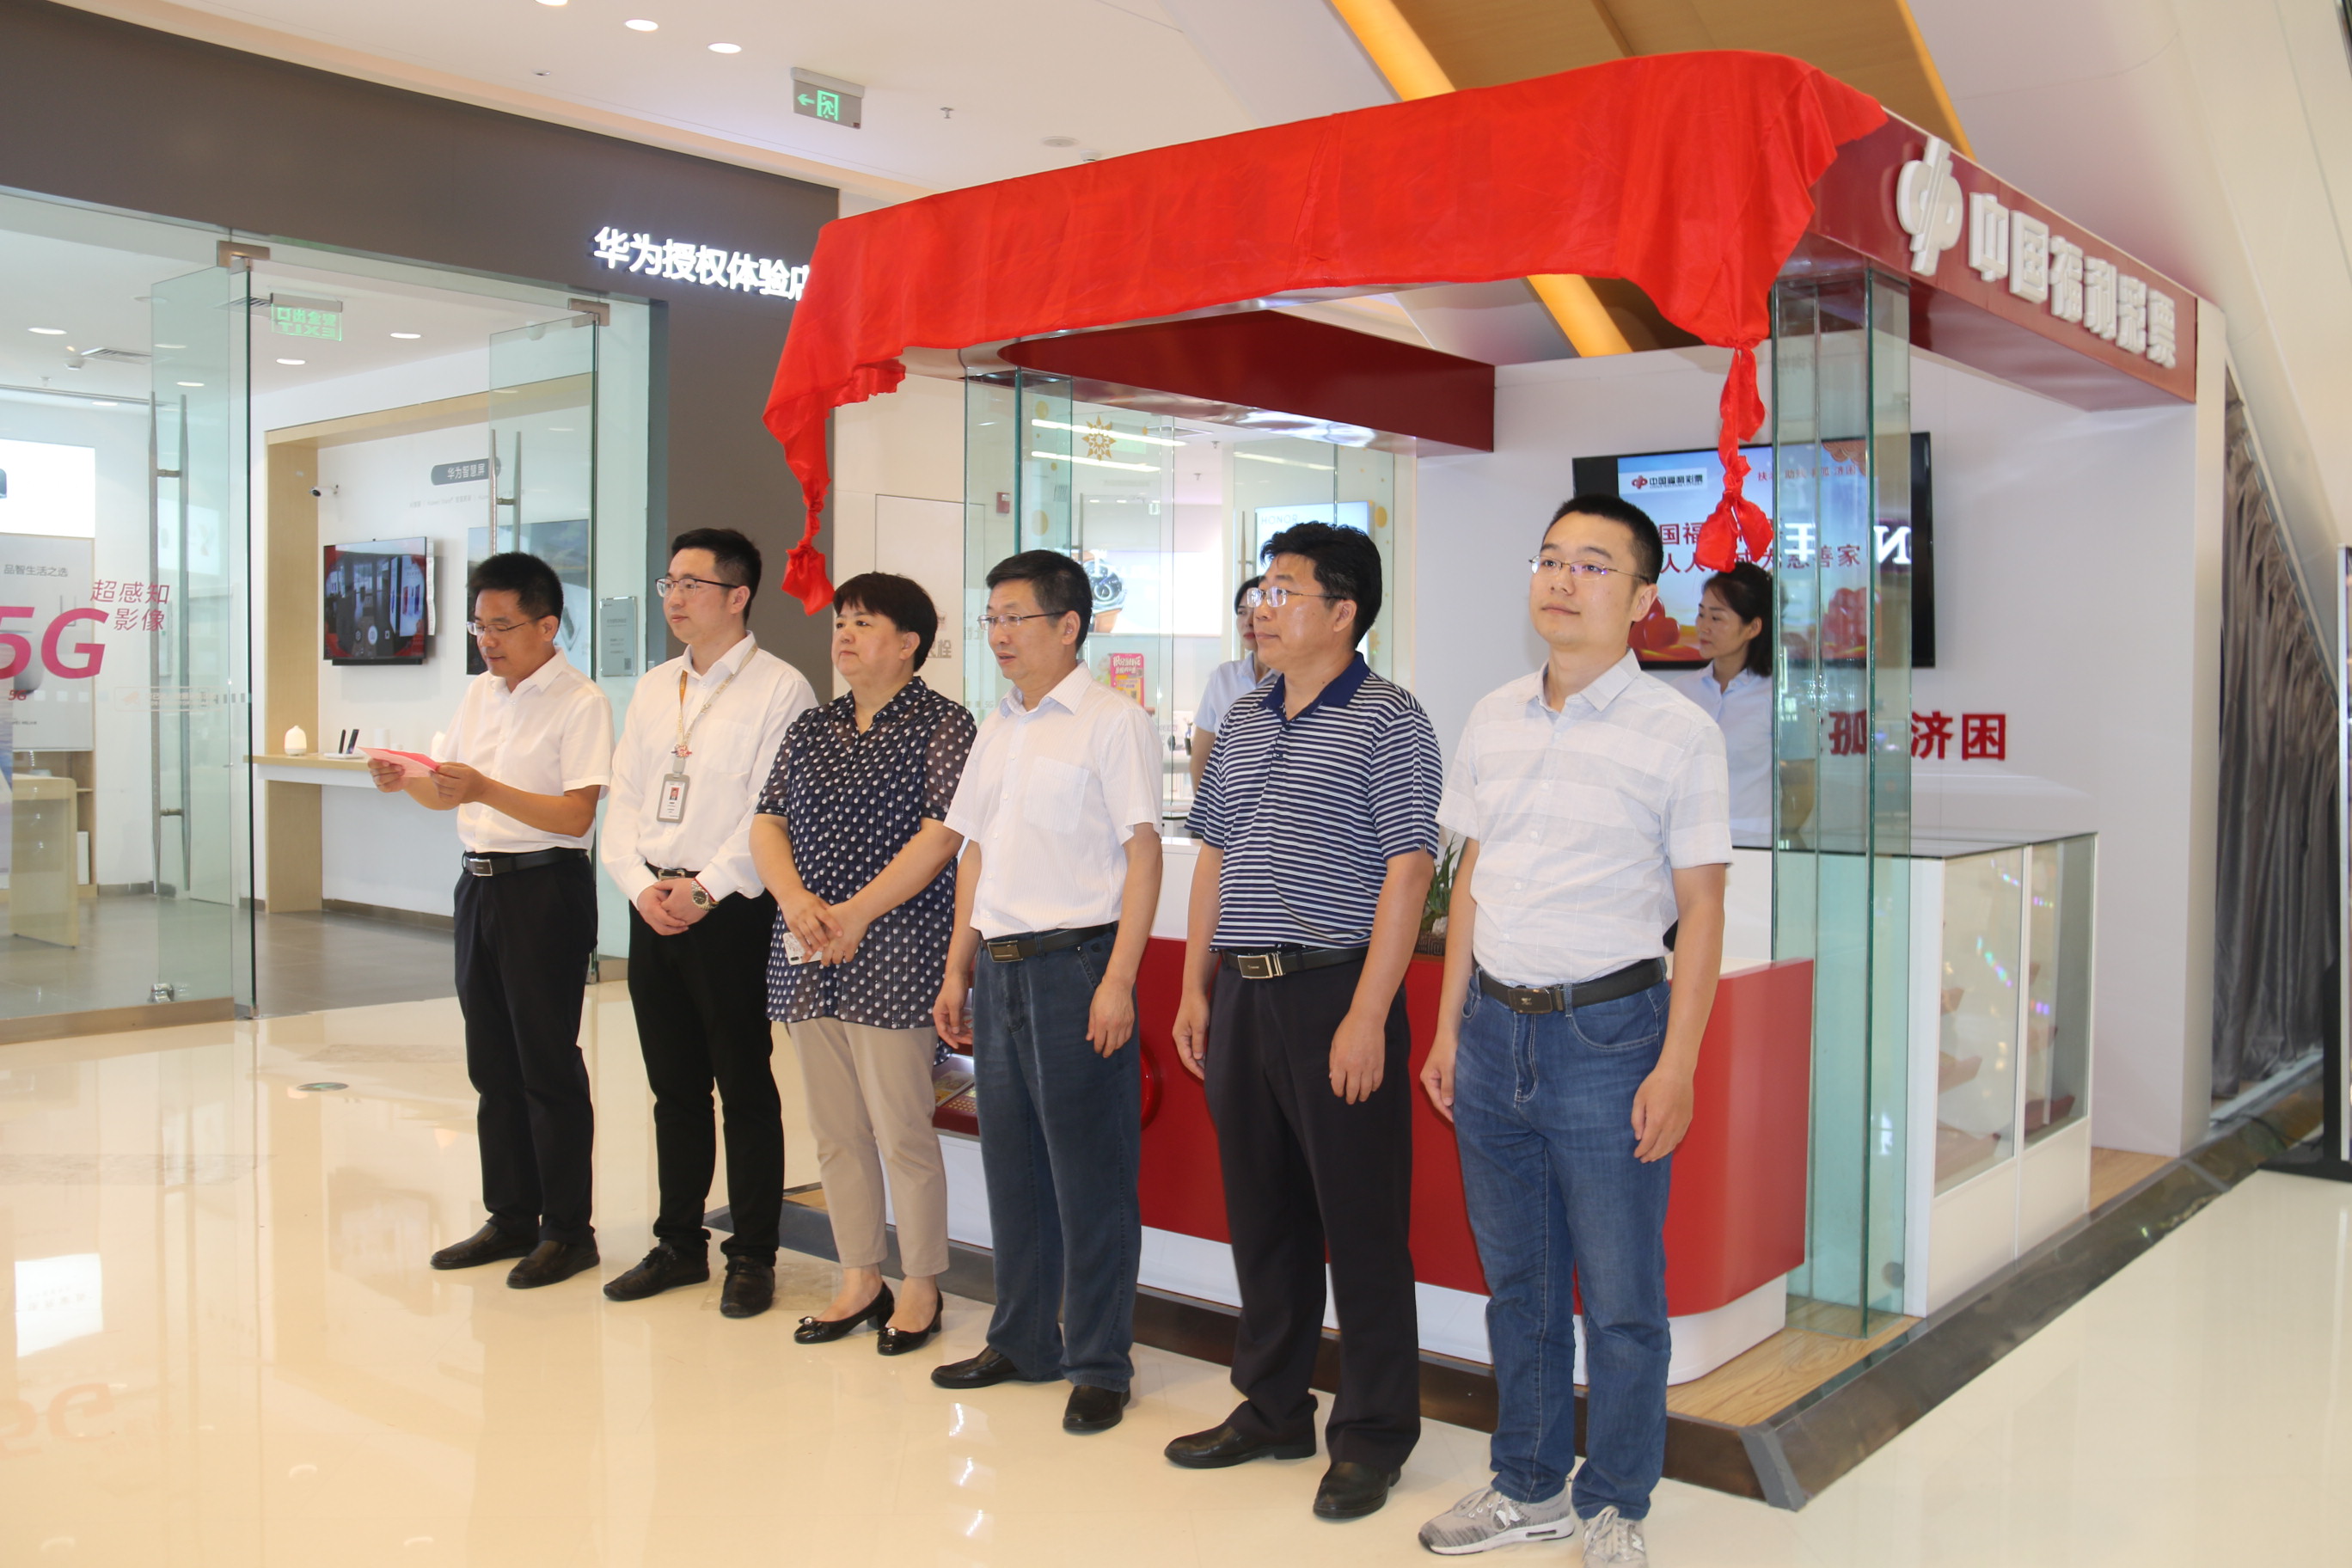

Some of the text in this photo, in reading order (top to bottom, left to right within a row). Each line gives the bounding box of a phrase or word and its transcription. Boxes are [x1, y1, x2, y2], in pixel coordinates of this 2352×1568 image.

[1969, 192, 2176, 369] 中国福利彩票
[1261, 514, 1298, 525] HONOR
[3, 565, 68, 577] 品智生活之选
[89, 579, 170, 605] 超感知
[113, 608, 165, 632] 影像
[0, 605, 110, 680] 5G
[1911, 711, 2006, 762] 济困
